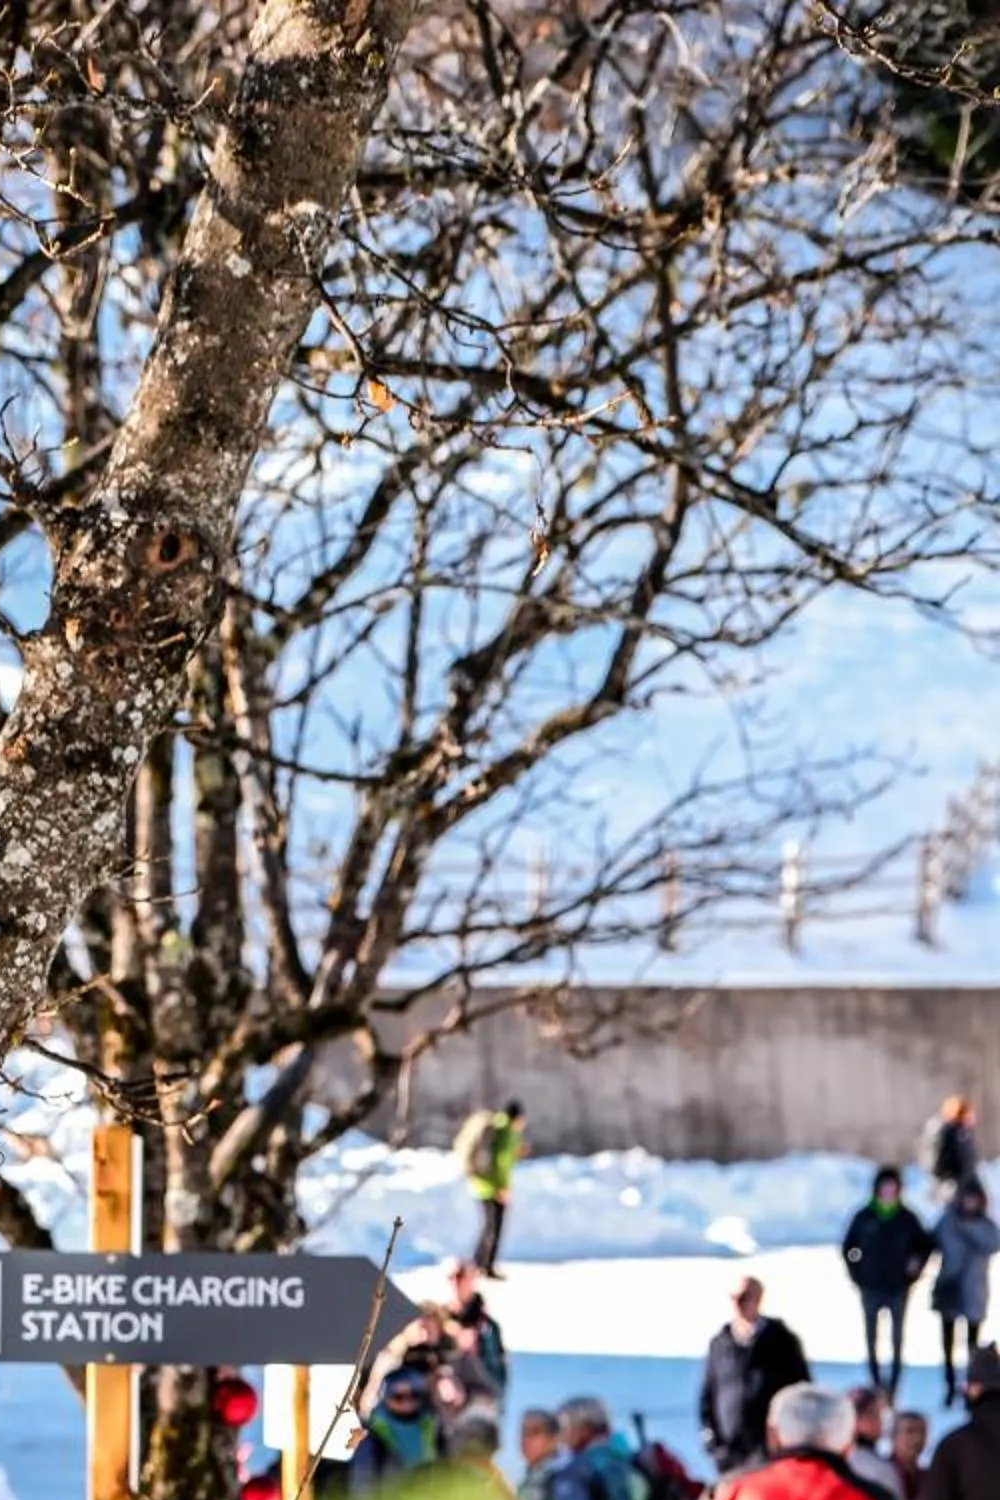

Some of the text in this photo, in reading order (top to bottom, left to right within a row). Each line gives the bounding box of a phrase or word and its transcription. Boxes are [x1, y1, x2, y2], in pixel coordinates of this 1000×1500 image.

[21, 1273, 306, 1308] E-BIKE CHARGING
[21, 1310, 164, 1343] STATION
